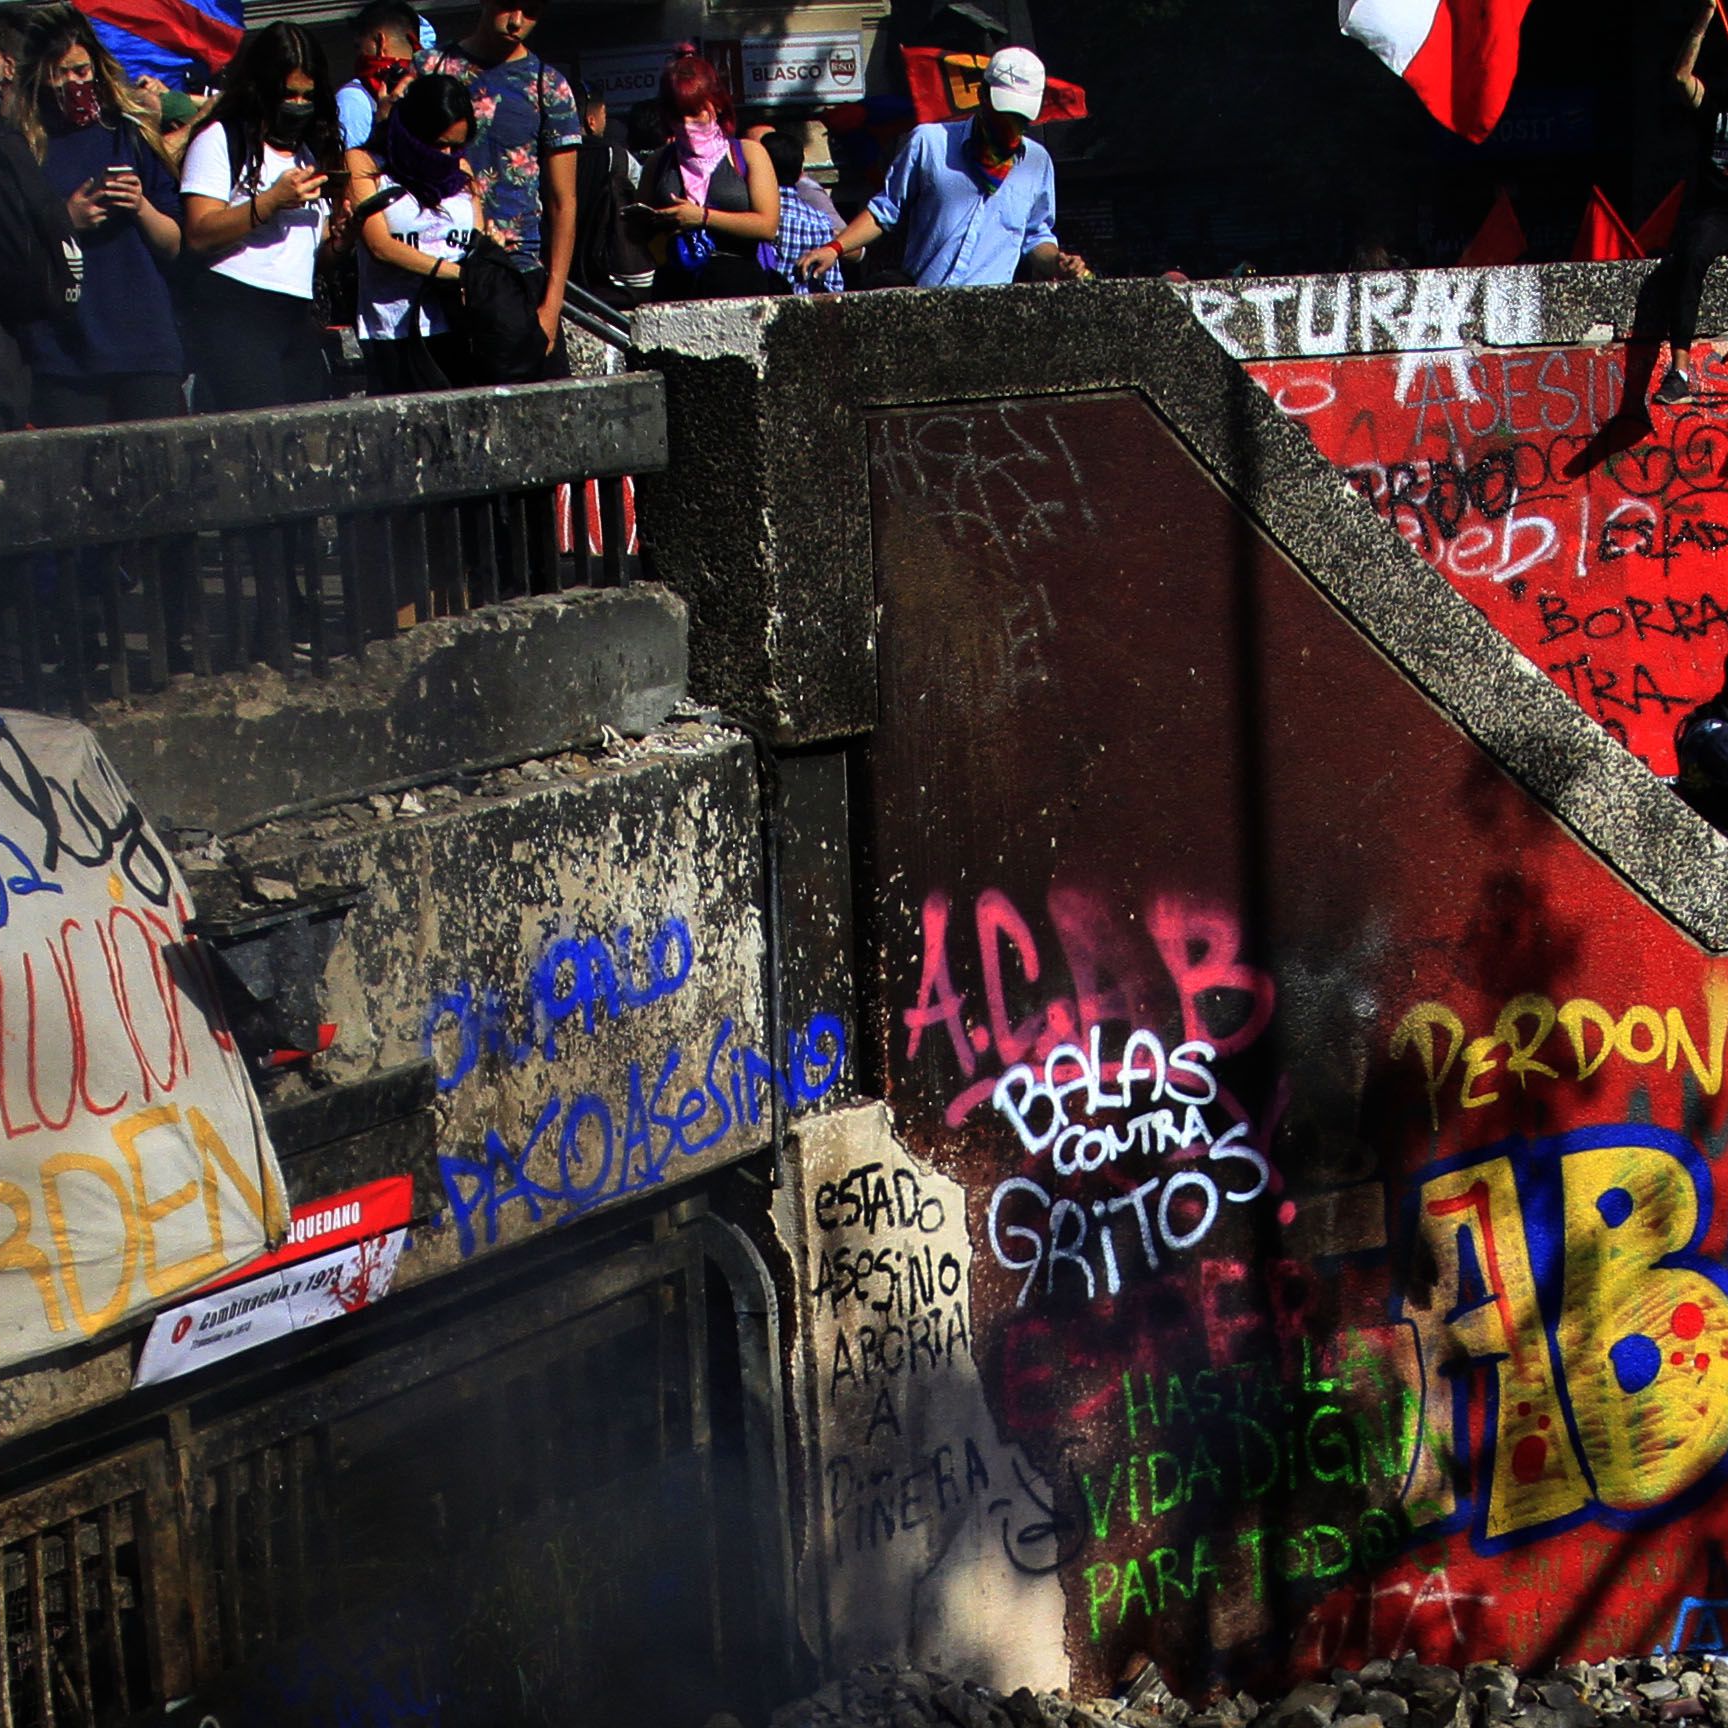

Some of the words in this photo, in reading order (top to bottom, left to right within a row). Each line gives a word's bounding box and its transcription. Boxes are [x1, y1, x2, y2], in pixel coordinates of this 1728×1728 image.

[752, 64, 822, 82] BLASCO
[992, 1024, 1217, 1154] BALAS
[1052, 1104, 1214, 1176] CONTRA
[287, 1200, 362, 1244] AQUEDANO
[199, 1284, 290, 1332] Combinación
[1300, 1325, 1386, 1396] LA
[1081, 1531, 1226, 1645] PARA
